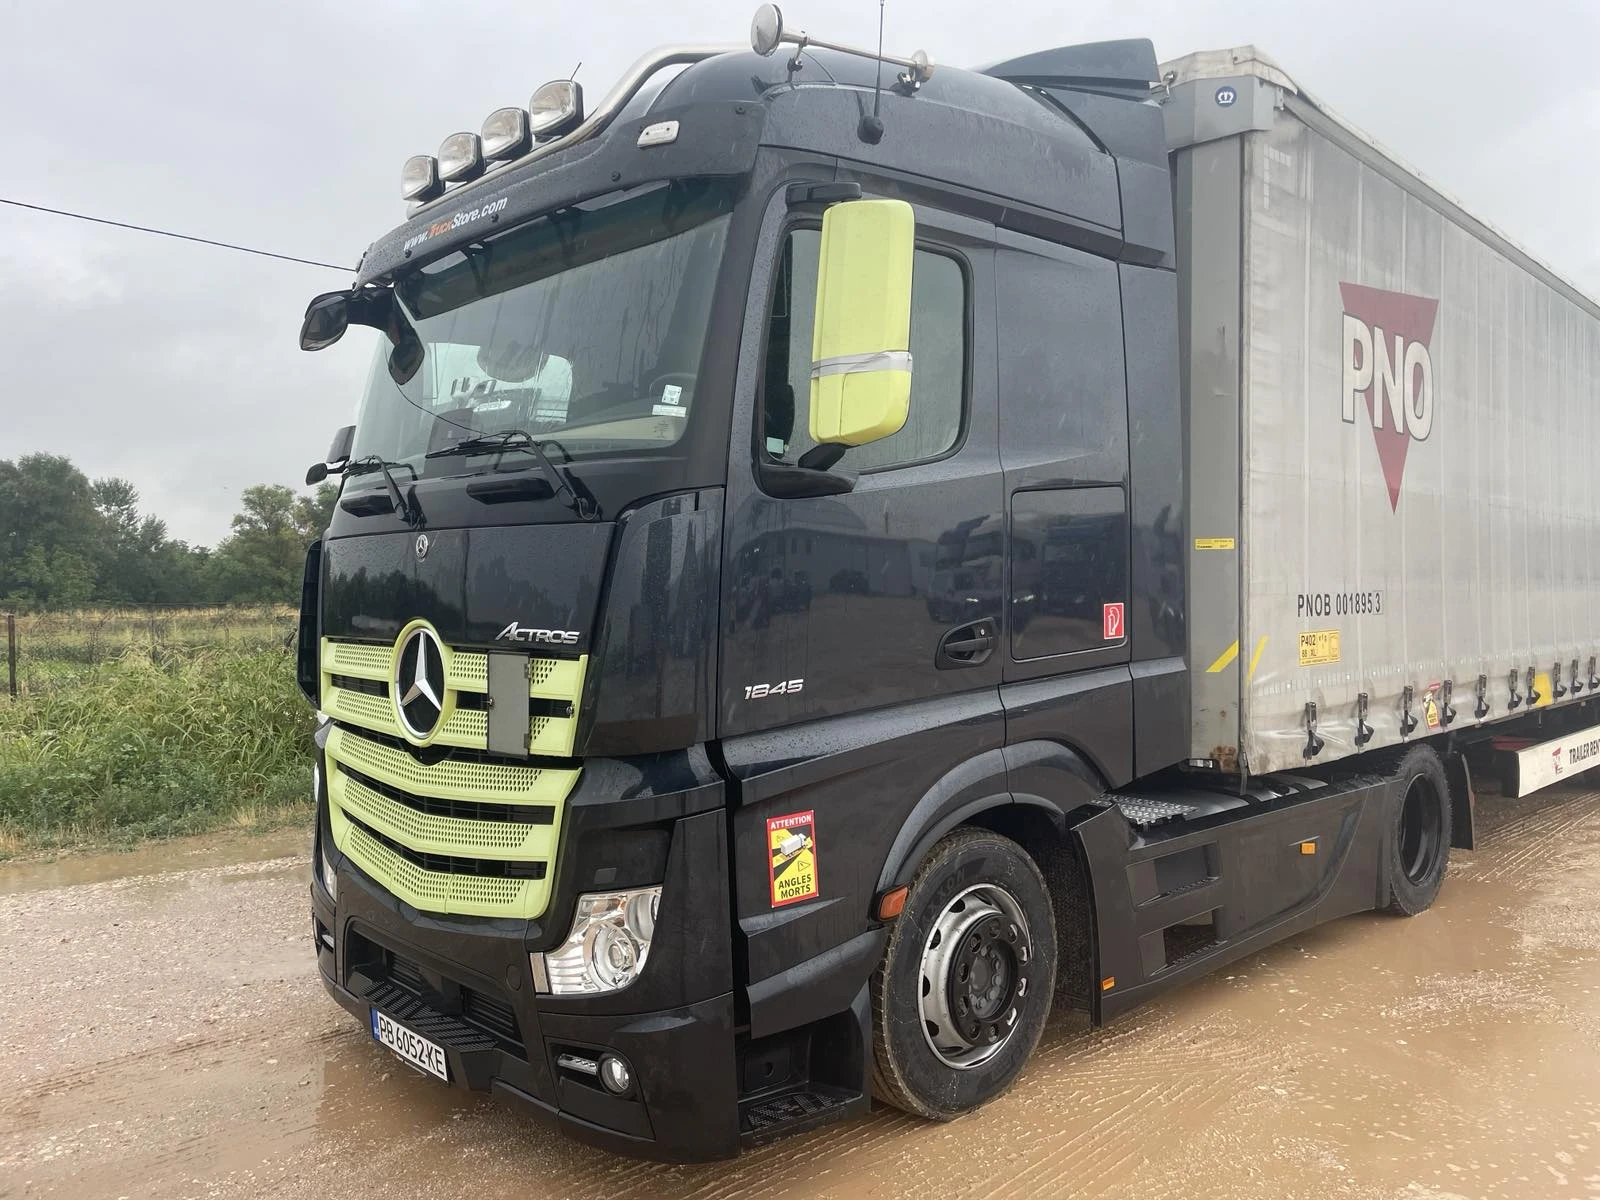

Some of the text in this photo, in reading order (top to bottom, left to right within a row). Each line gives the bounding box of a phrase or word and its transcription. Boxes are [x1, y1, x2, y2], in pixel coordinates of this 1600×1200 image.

[1342, 311, 1433, 441] PNO
[1297, 593, 1331, 617] PNOB
[744, 679, 804, 700] 1845
[1569, 742, 1590, 764] TRAILER
[770, 814, 812, 830] ATTENTION
[778, 873, 812, 890] ANGLES
[780, 883, 811, 900] MORTS
